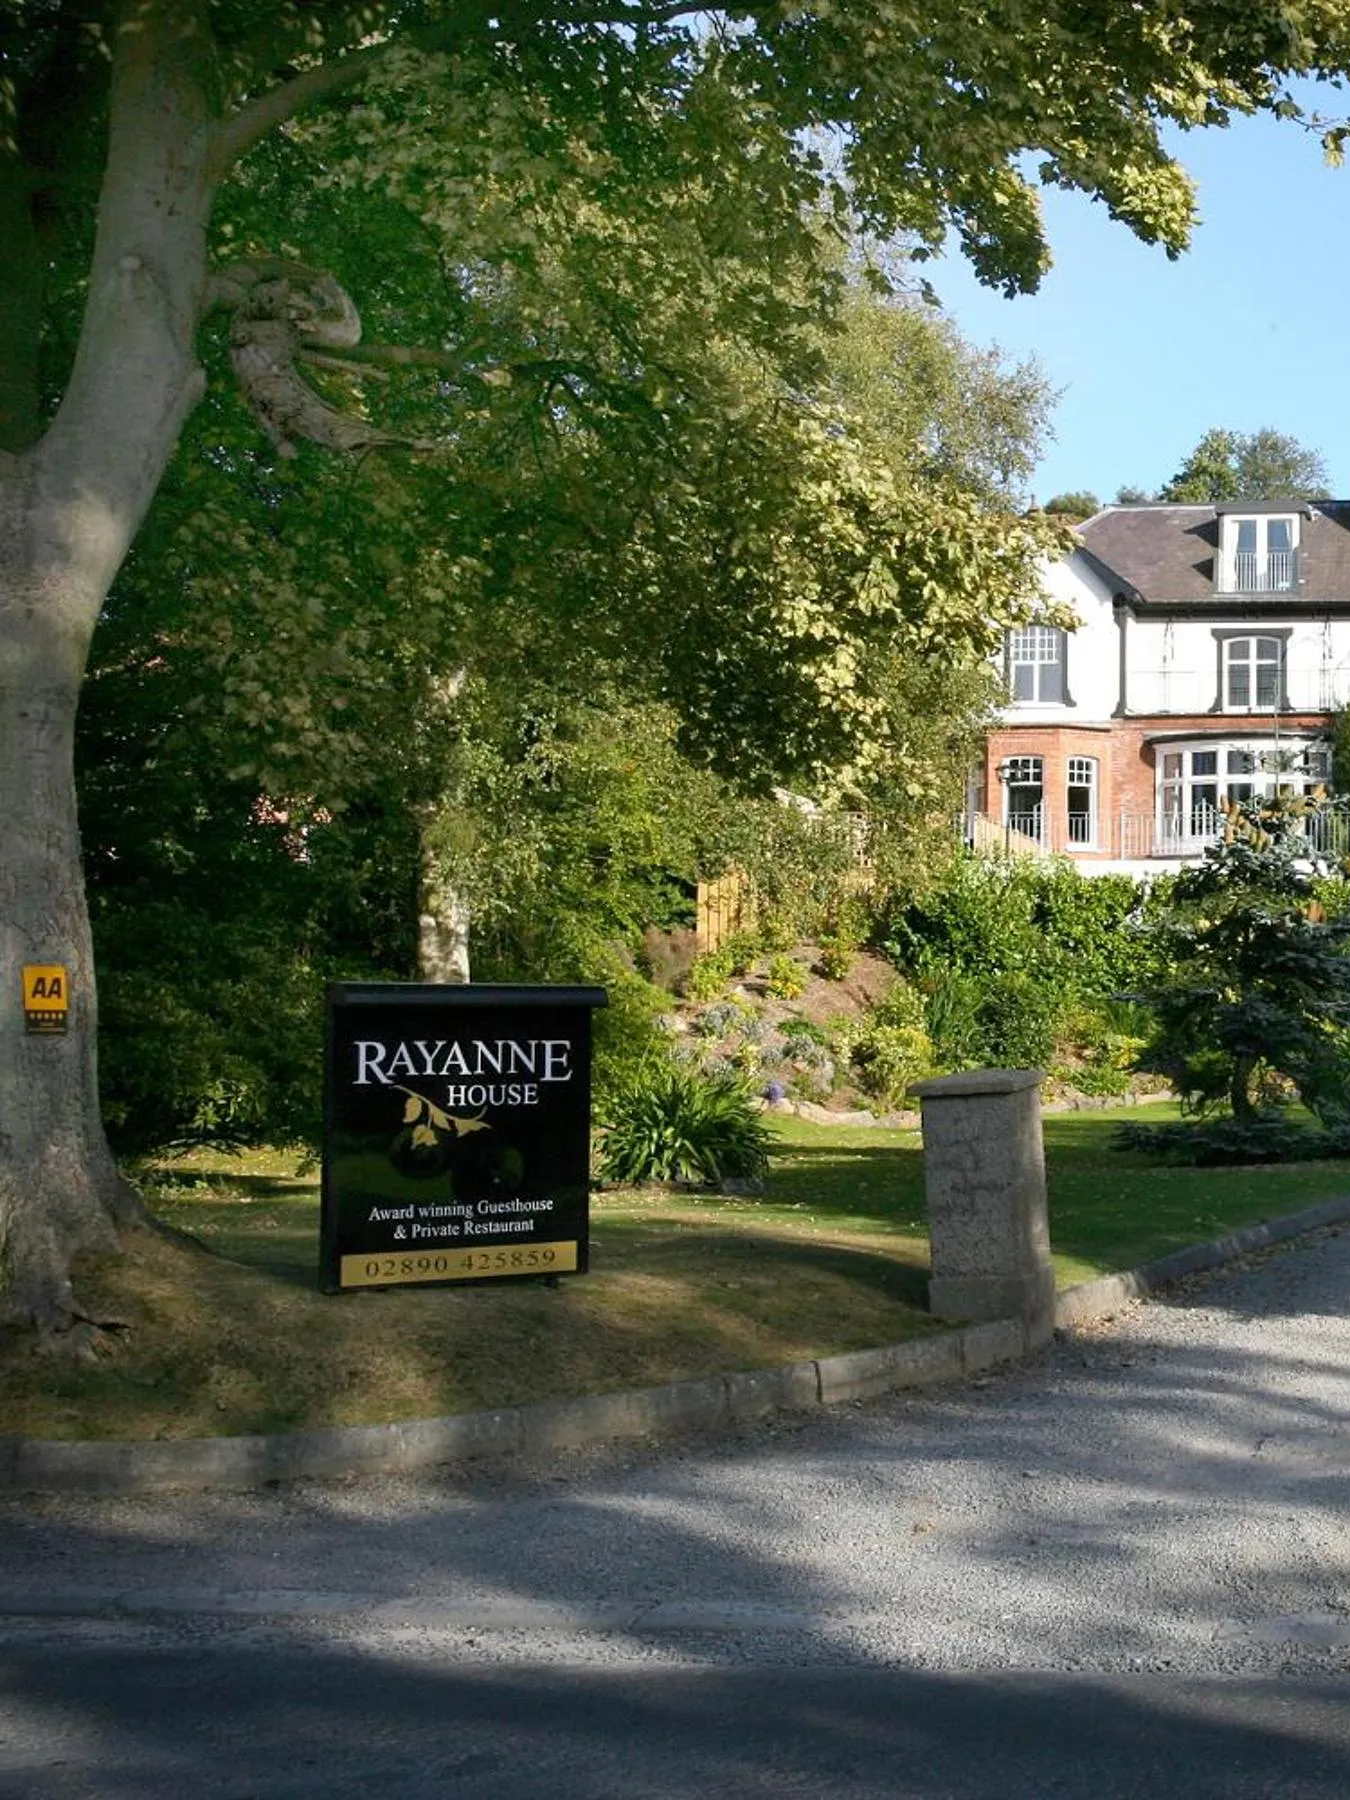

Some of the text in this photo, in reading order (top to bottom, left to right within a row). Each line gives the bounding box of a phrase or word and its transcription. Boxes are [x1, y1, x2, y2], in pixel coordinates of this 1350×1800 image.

[31, 977, 62, 999] AA
[353, 1039, 573, 1085] RAYANNE
[448, 1083, 539, 1106] HOUSE
[368, 1198, 554, 1221] Award winning Guesthouse
[393, 1219, 534, 1239] & Private Restaurant
[365, 1249, 556, 1278] 02890 425859
